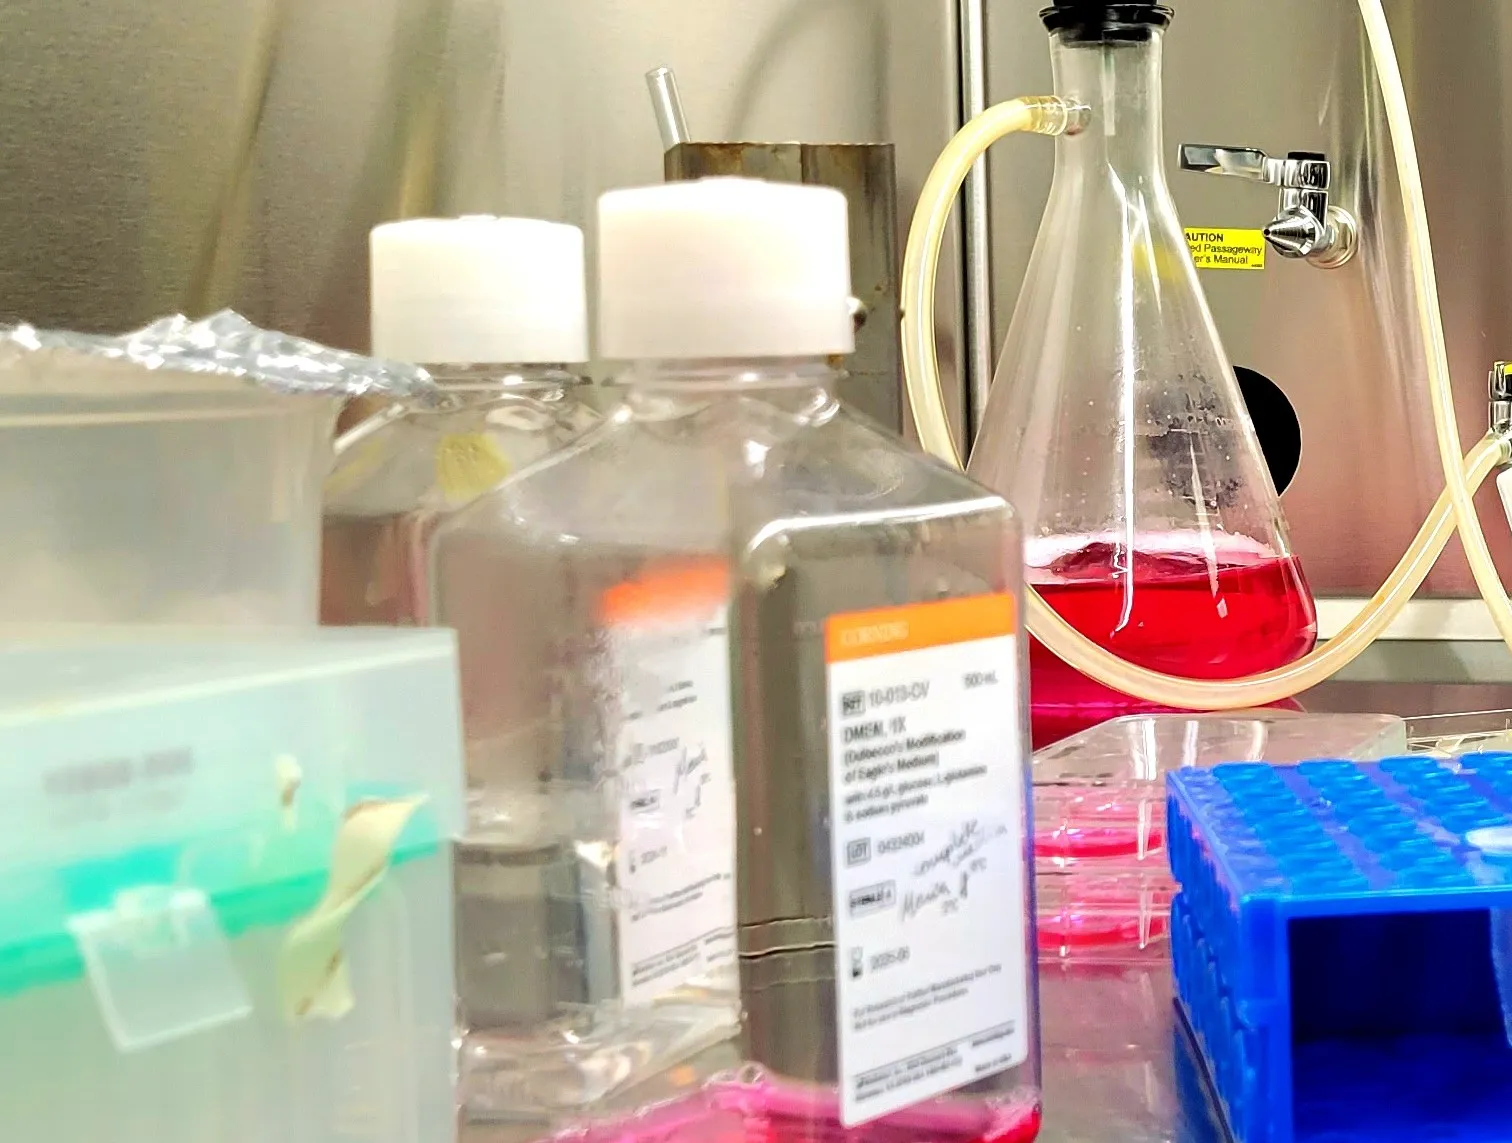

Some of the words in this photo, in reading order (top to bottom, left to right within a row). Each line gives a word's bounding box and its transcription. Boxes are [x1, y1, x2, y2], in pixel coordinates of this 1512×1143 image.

[1185, 232, 1224, 242] AUTION
[1190, 244, 1201, 253] ed
[1204, 244, 1263, 256] Passageway
[1193, 254, 1211, 263] er's
[1213, 254, 1248, 264] Manual
